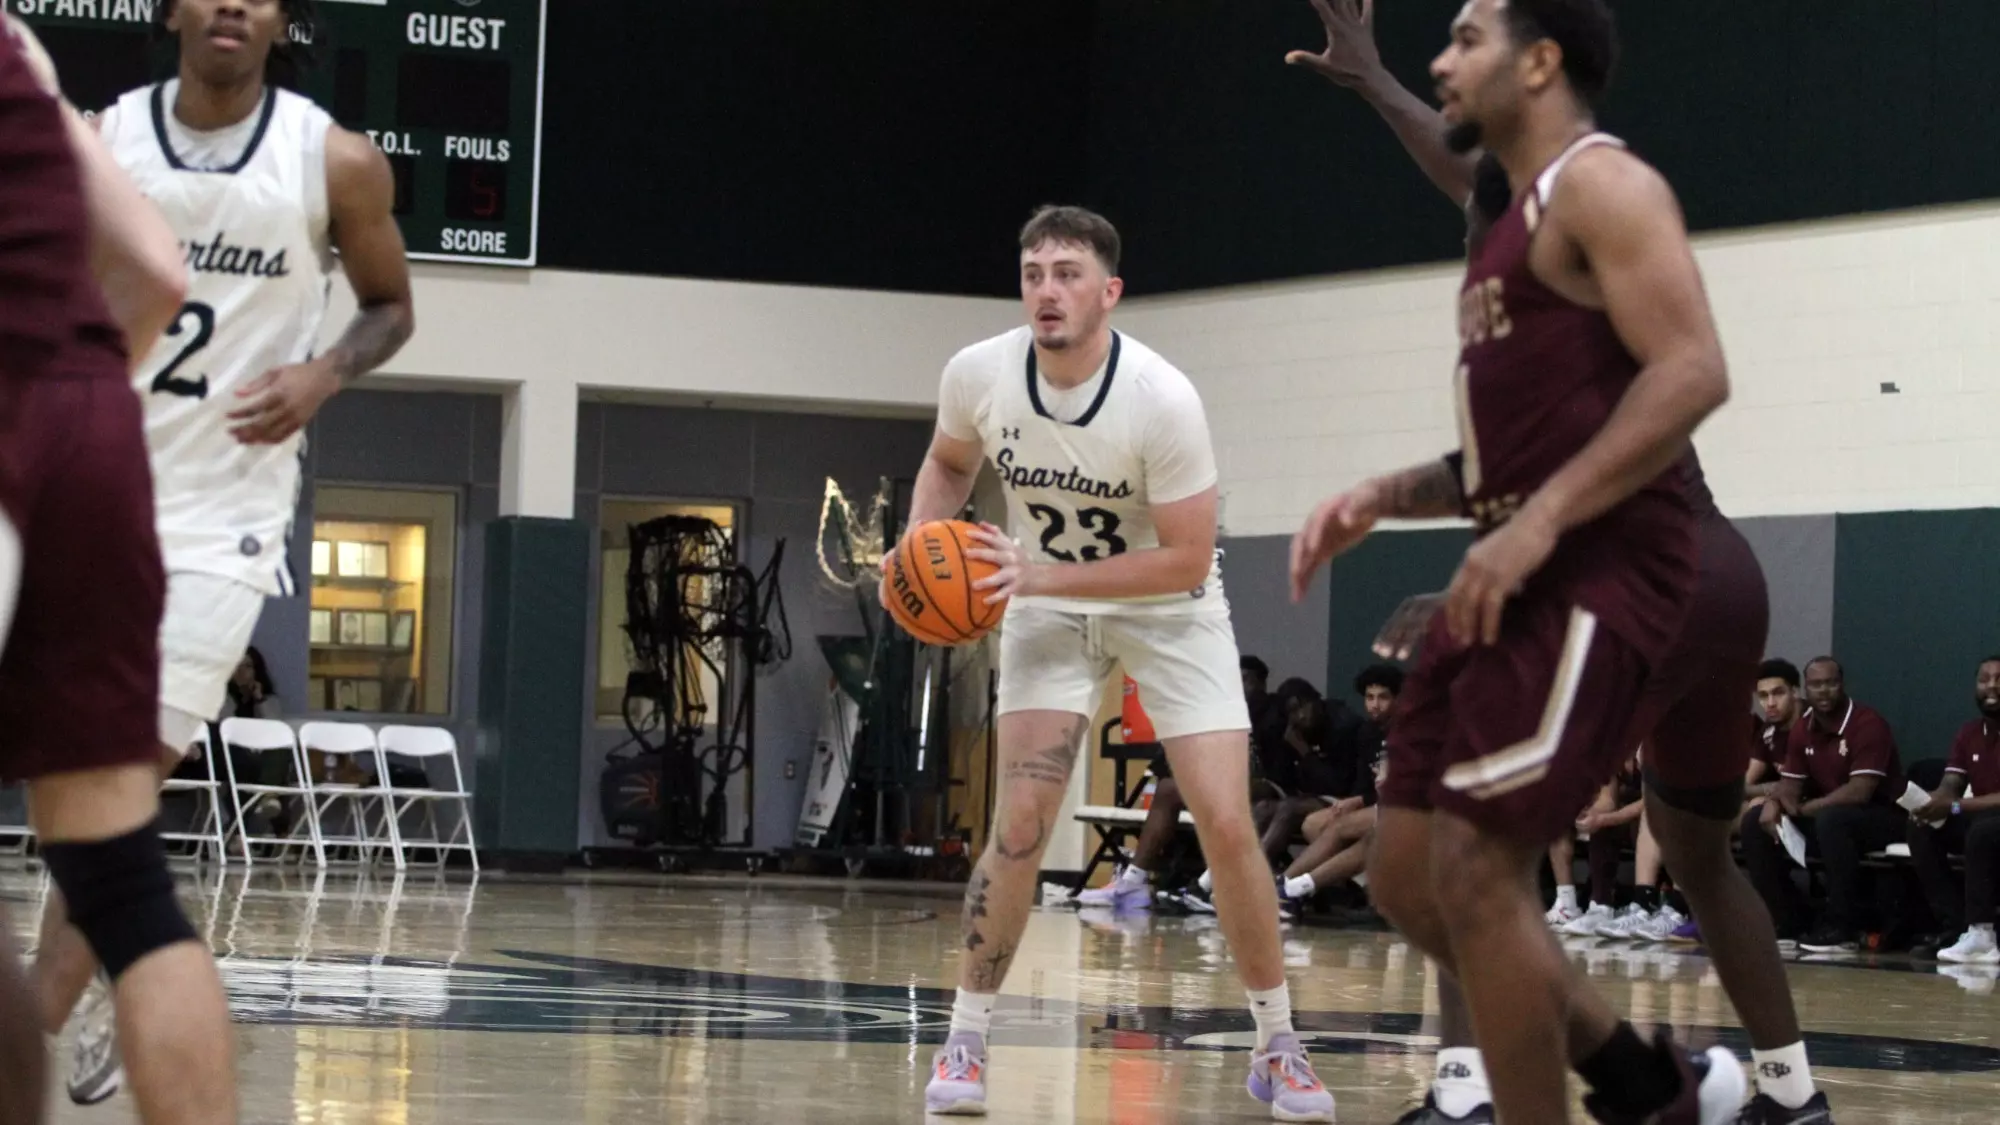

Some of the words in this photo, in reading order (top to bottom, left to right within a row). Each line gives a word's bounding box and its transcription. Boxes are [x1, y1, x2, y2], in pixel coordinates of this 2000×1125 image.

[406, 12, 506, 50] GUEST
[445, 136, 511, 162] FOULS
[180, 230, 290, 278] rtans
[441, 227, 507, 253] SCORE
[151, 301, 216, 400] 2
[996, 447, 1135, 500] Spartans
[1024, 501, 1128, 563] 23
